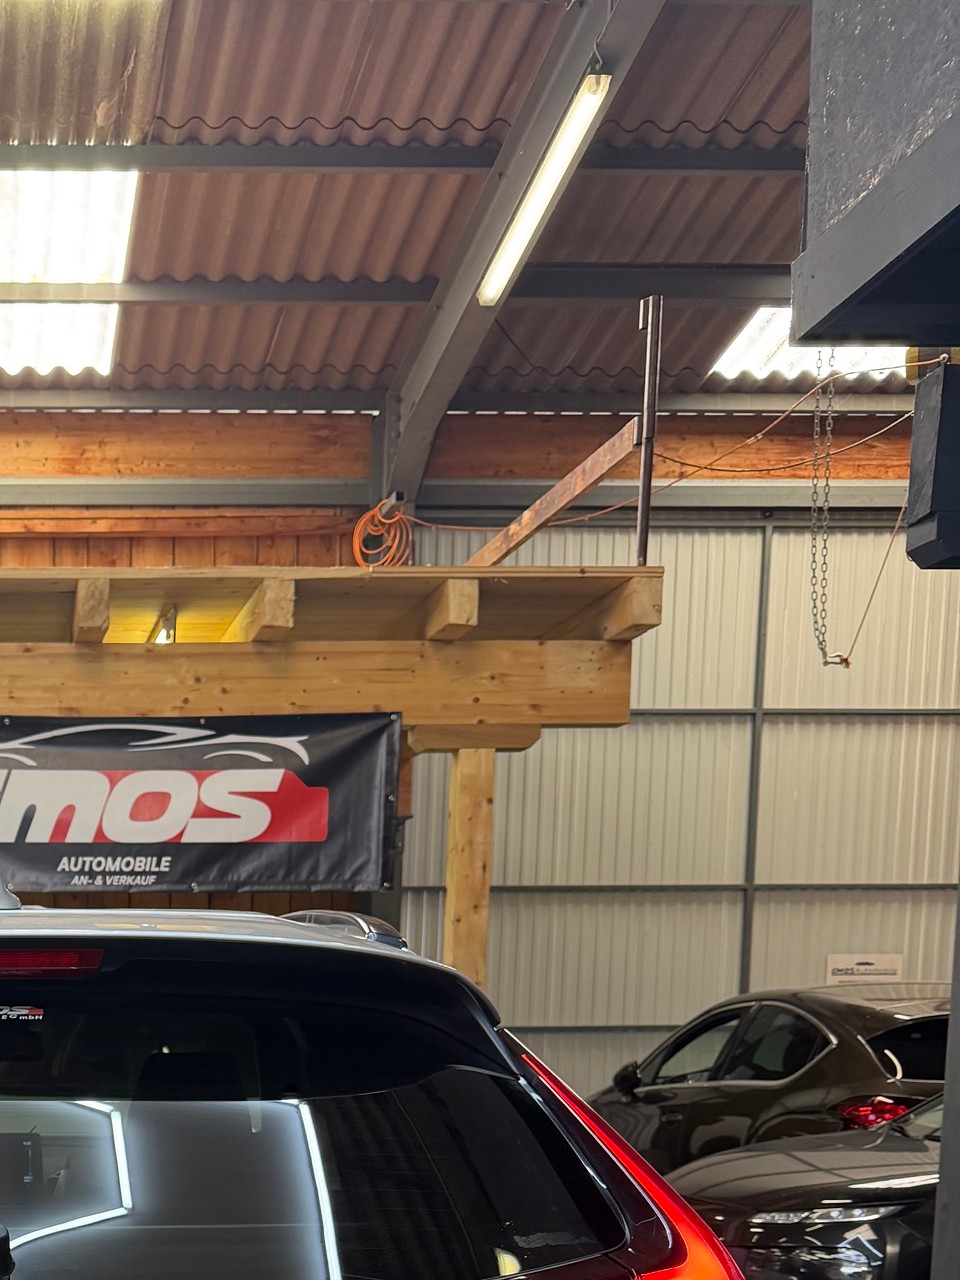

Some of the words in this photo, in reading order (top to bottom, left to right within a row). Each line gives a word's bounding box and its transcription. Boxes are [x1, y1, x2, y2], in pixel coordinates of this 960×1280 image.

[56, 856, 173, 872] AUTOMOBILE
[70, 875, 92, 886] AN-
[94, 875, 103, 886] &
[105, 875, 157, 886] VERKAUF
